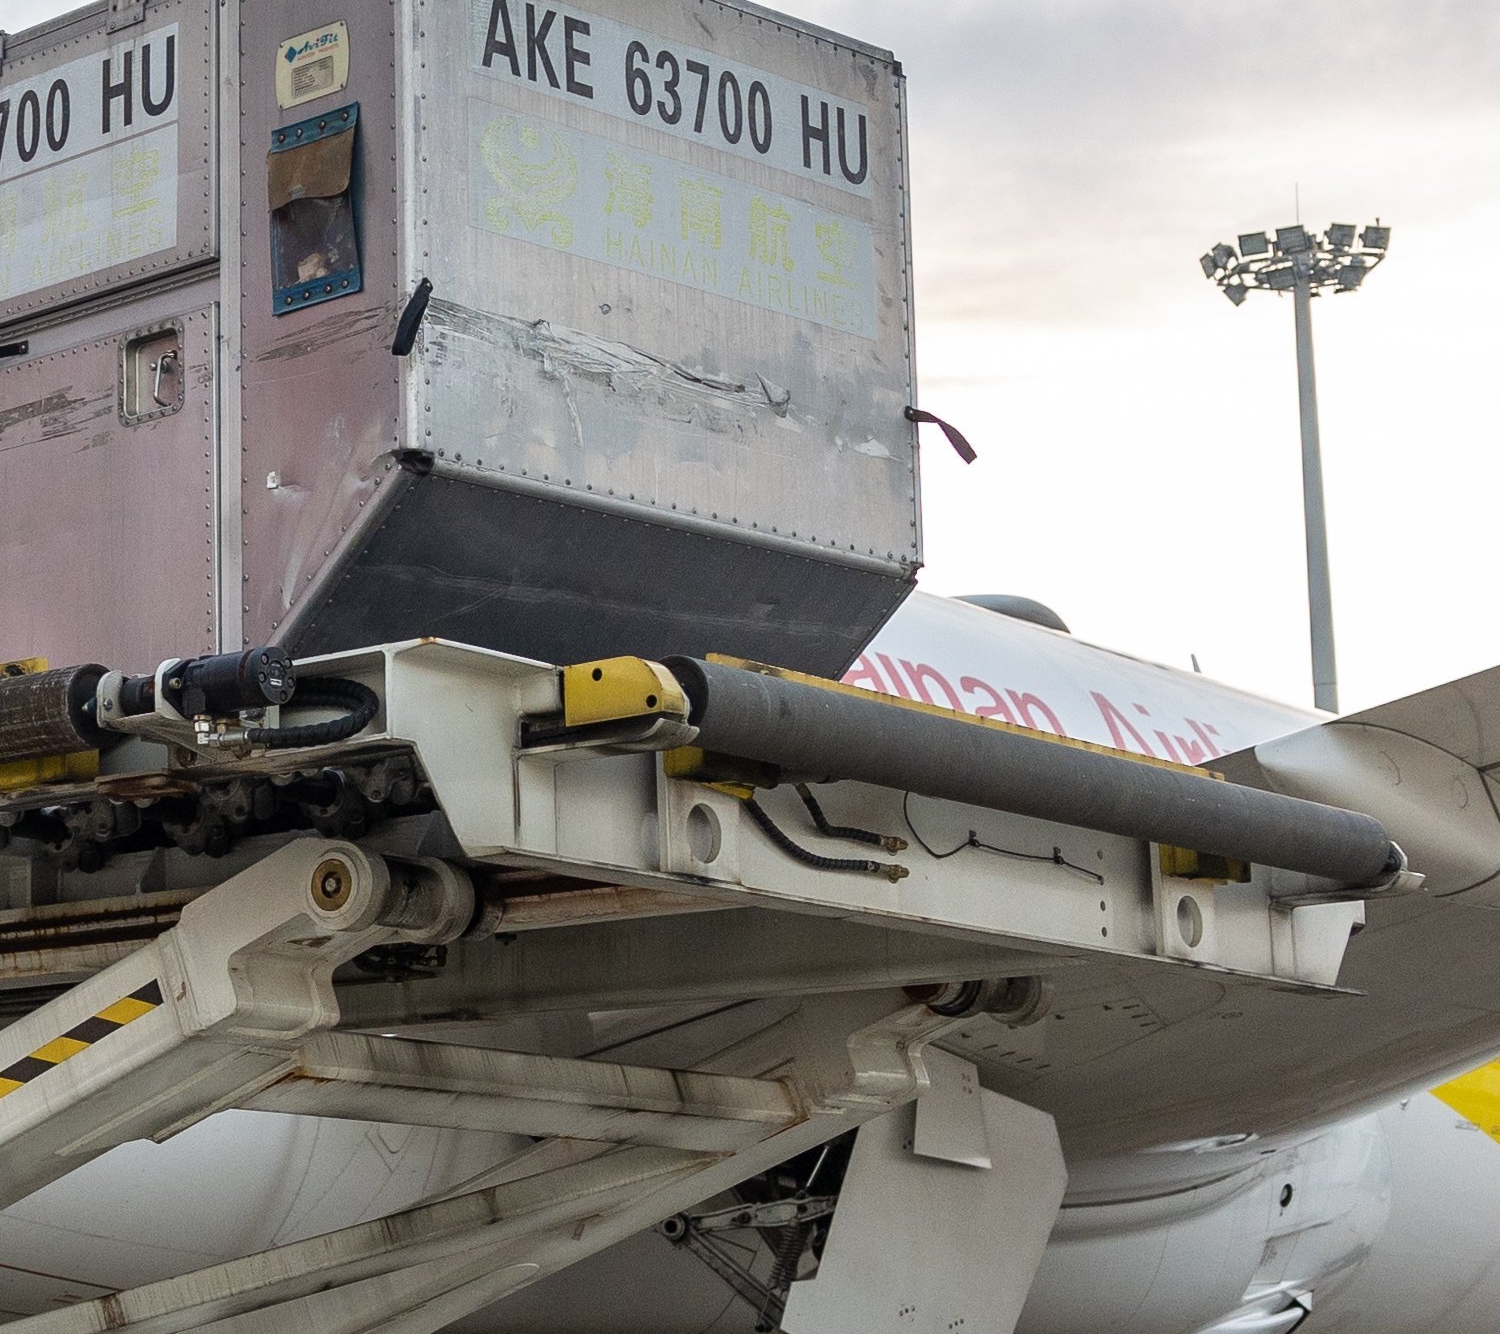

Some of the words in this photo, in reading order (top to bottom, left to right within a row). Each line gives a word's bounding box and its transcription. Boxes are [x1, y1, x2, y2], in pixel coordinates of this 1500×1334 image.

[101, 35, 176, 134] HU
[624, 40, 773, 154] 63700
[802, 94, 868, 185] HU
[605, 227, 718, 285] HAINAN
